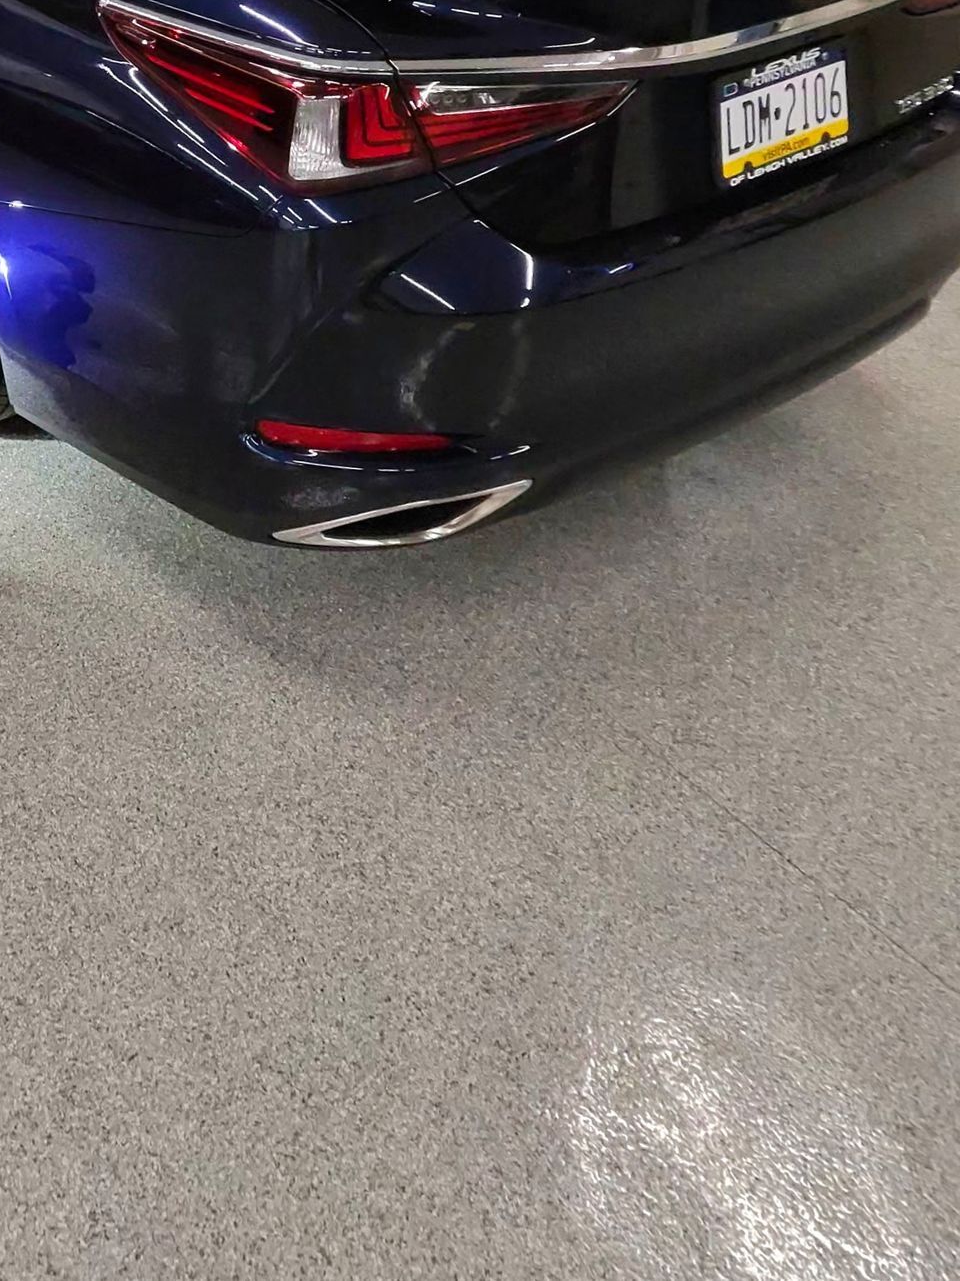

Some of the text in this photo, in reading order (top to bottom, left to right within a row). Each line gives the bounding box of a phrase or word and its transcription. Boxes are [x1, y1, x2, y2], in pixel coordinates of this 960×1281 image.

[751, 47, 821, 76] LEXUS
[730, 174, 746, 187] OF
[746, 158, 786, 180] LEHIGH
